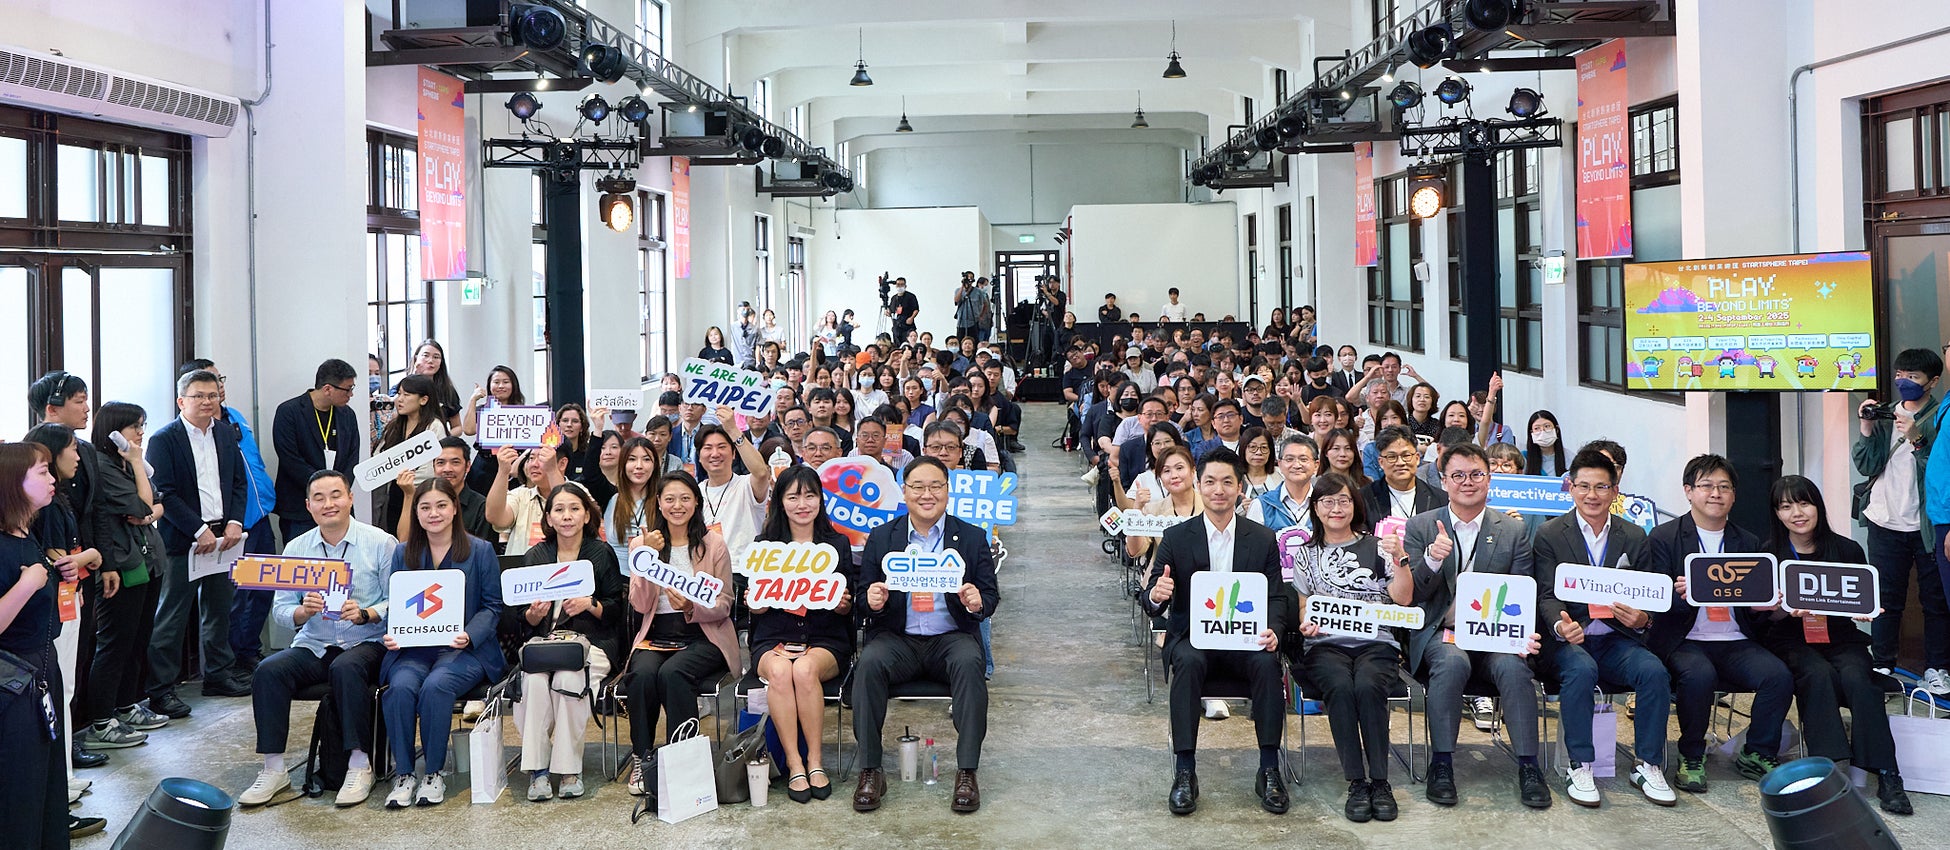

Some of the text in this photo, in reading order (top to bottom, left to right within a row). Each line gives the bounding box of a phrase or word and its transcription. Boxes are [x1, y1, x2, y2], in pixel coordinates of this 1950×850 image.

[1583, 131, 1622, 168] PLAY
[425, 155, 461, 191] PLAY
[1583, 165, 1623, 183] BEYOND LIMITS
[426, 190, 446, 205] BEYOND
[1709, 274, 1775, 298] PLAY
[1697, 299, 1790, 312] BEYOND LIMITS
[1698, 311, 1790, 322] 2-4 September 2025
[685, 363, 758, 387] WE ARE IN
[688, 378, 771, 413] TAIPEI
[487, 414, 544, 426] BEYOND
[486, 427, 531, 439] LIMITS
[371, 440, 432, 478] underDOC
[1488, 487, 1573, 502] nteractiVerse
[823, 492, 894, 529] loba
[1127, 517, 1181, 528] 臺北市政府
[746, 548, 831, 574] HELLO
[887, 549, 960, 573] GIPA
[259, 564, 325, 585] PLAY
[633, 550, 713, 603] Canada
[890, 576, 957, 588] 고양산업진흥원
[514, 580, 543, 594] DITP
[754, 577, 839, 602] TAIPEI
[1580, 578, 1665, 600] VinaCapital
[1713, 588, 1743, 597] ase
[1798, 572, 1860, 598] DLE
[1311, 601, 1362, 617] START
[393, 625, 459, 635] TECHSAUCE
[1200, 619, 1257, 636] TAIPEI
[1310, 615, 1373, 634] SPHERE
[1466, 621, 1525, 639] TAIPEI
